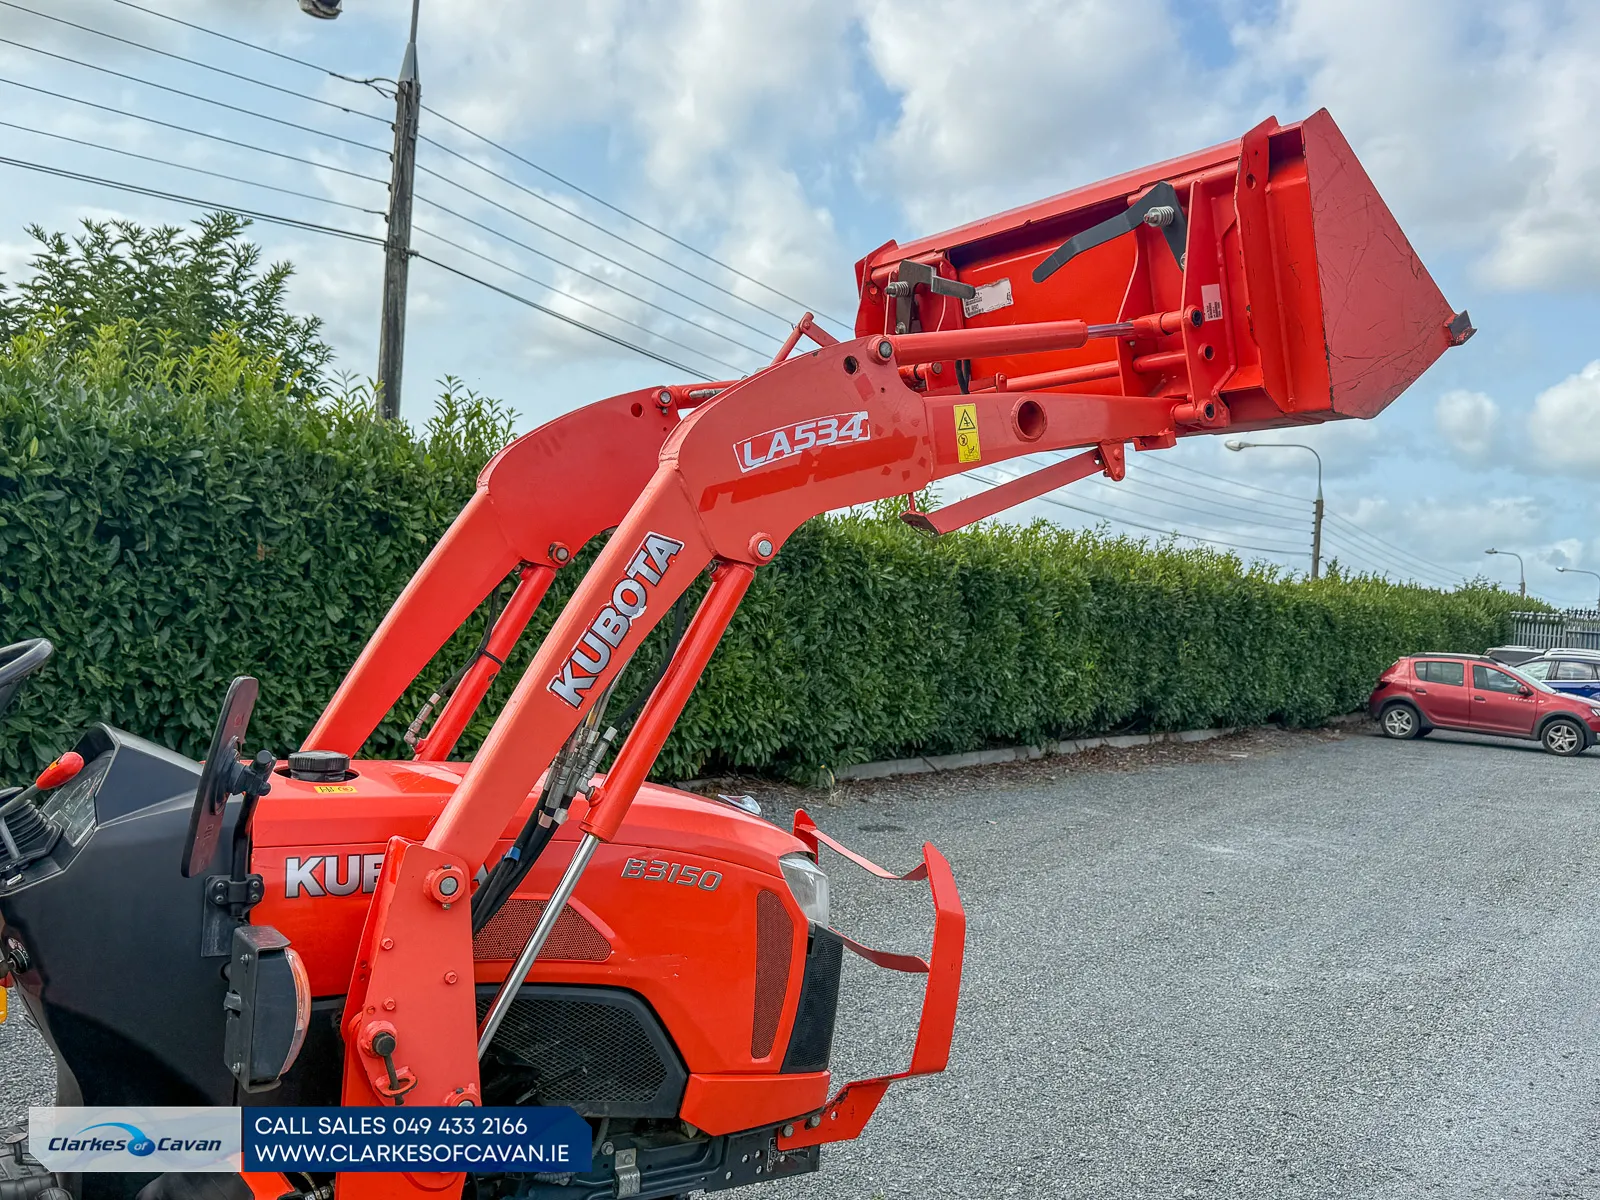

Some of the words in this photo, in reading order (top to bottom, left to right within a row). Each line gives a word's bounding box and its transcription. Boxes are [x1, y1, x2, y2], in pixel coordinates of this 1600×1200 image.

[743, 414, 863, 467] LA534
[549, 533, 684, 709] KUBOTA
[621, 857, 723, 893] B3150
